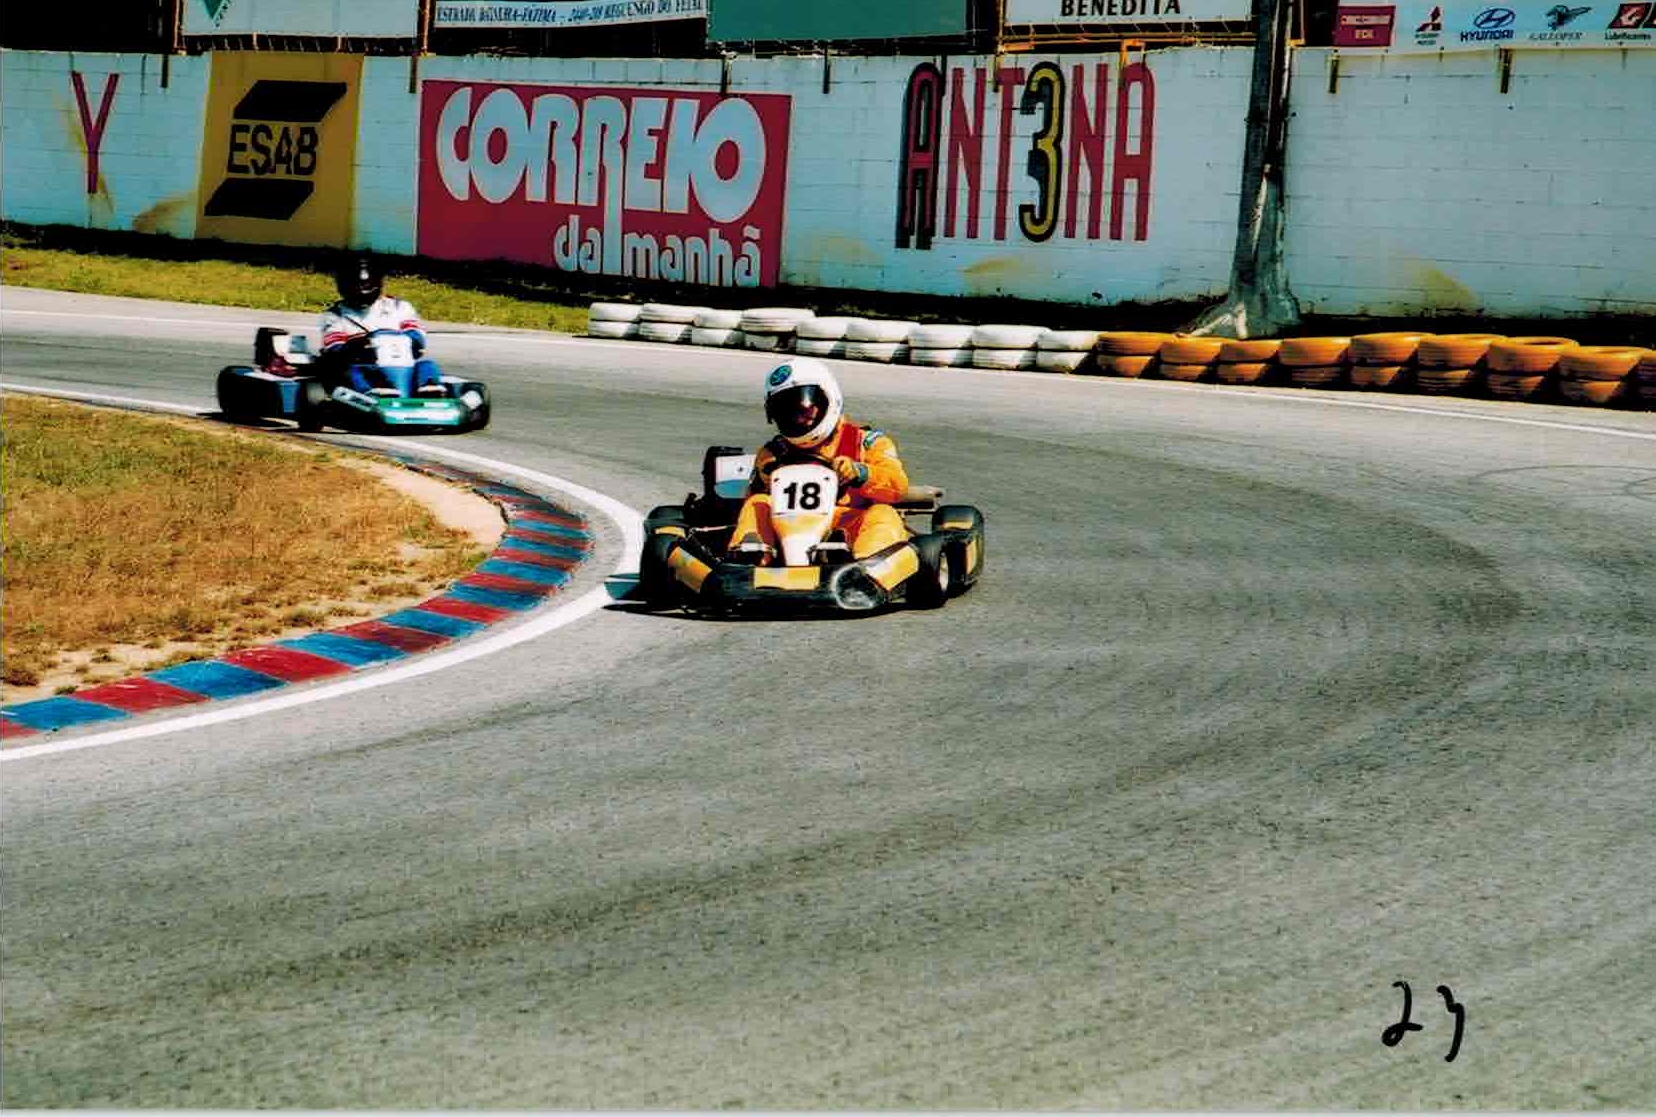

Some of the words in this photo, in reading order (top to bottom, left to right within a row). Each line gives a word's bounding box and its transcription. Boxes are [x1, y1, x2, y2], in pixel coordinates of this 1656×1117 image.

[1061, 0, 1181, 16] BENEDITA
[1460, 29, 1515, 42] HYUNDAI
[227, 124, 319, 176] ESAB
[437, 86, 767, 224] CORREIO
[554, 214, 603, 274] da
[623, 225, 762, 287] manhã
[783, 482, 822, 510] 18
